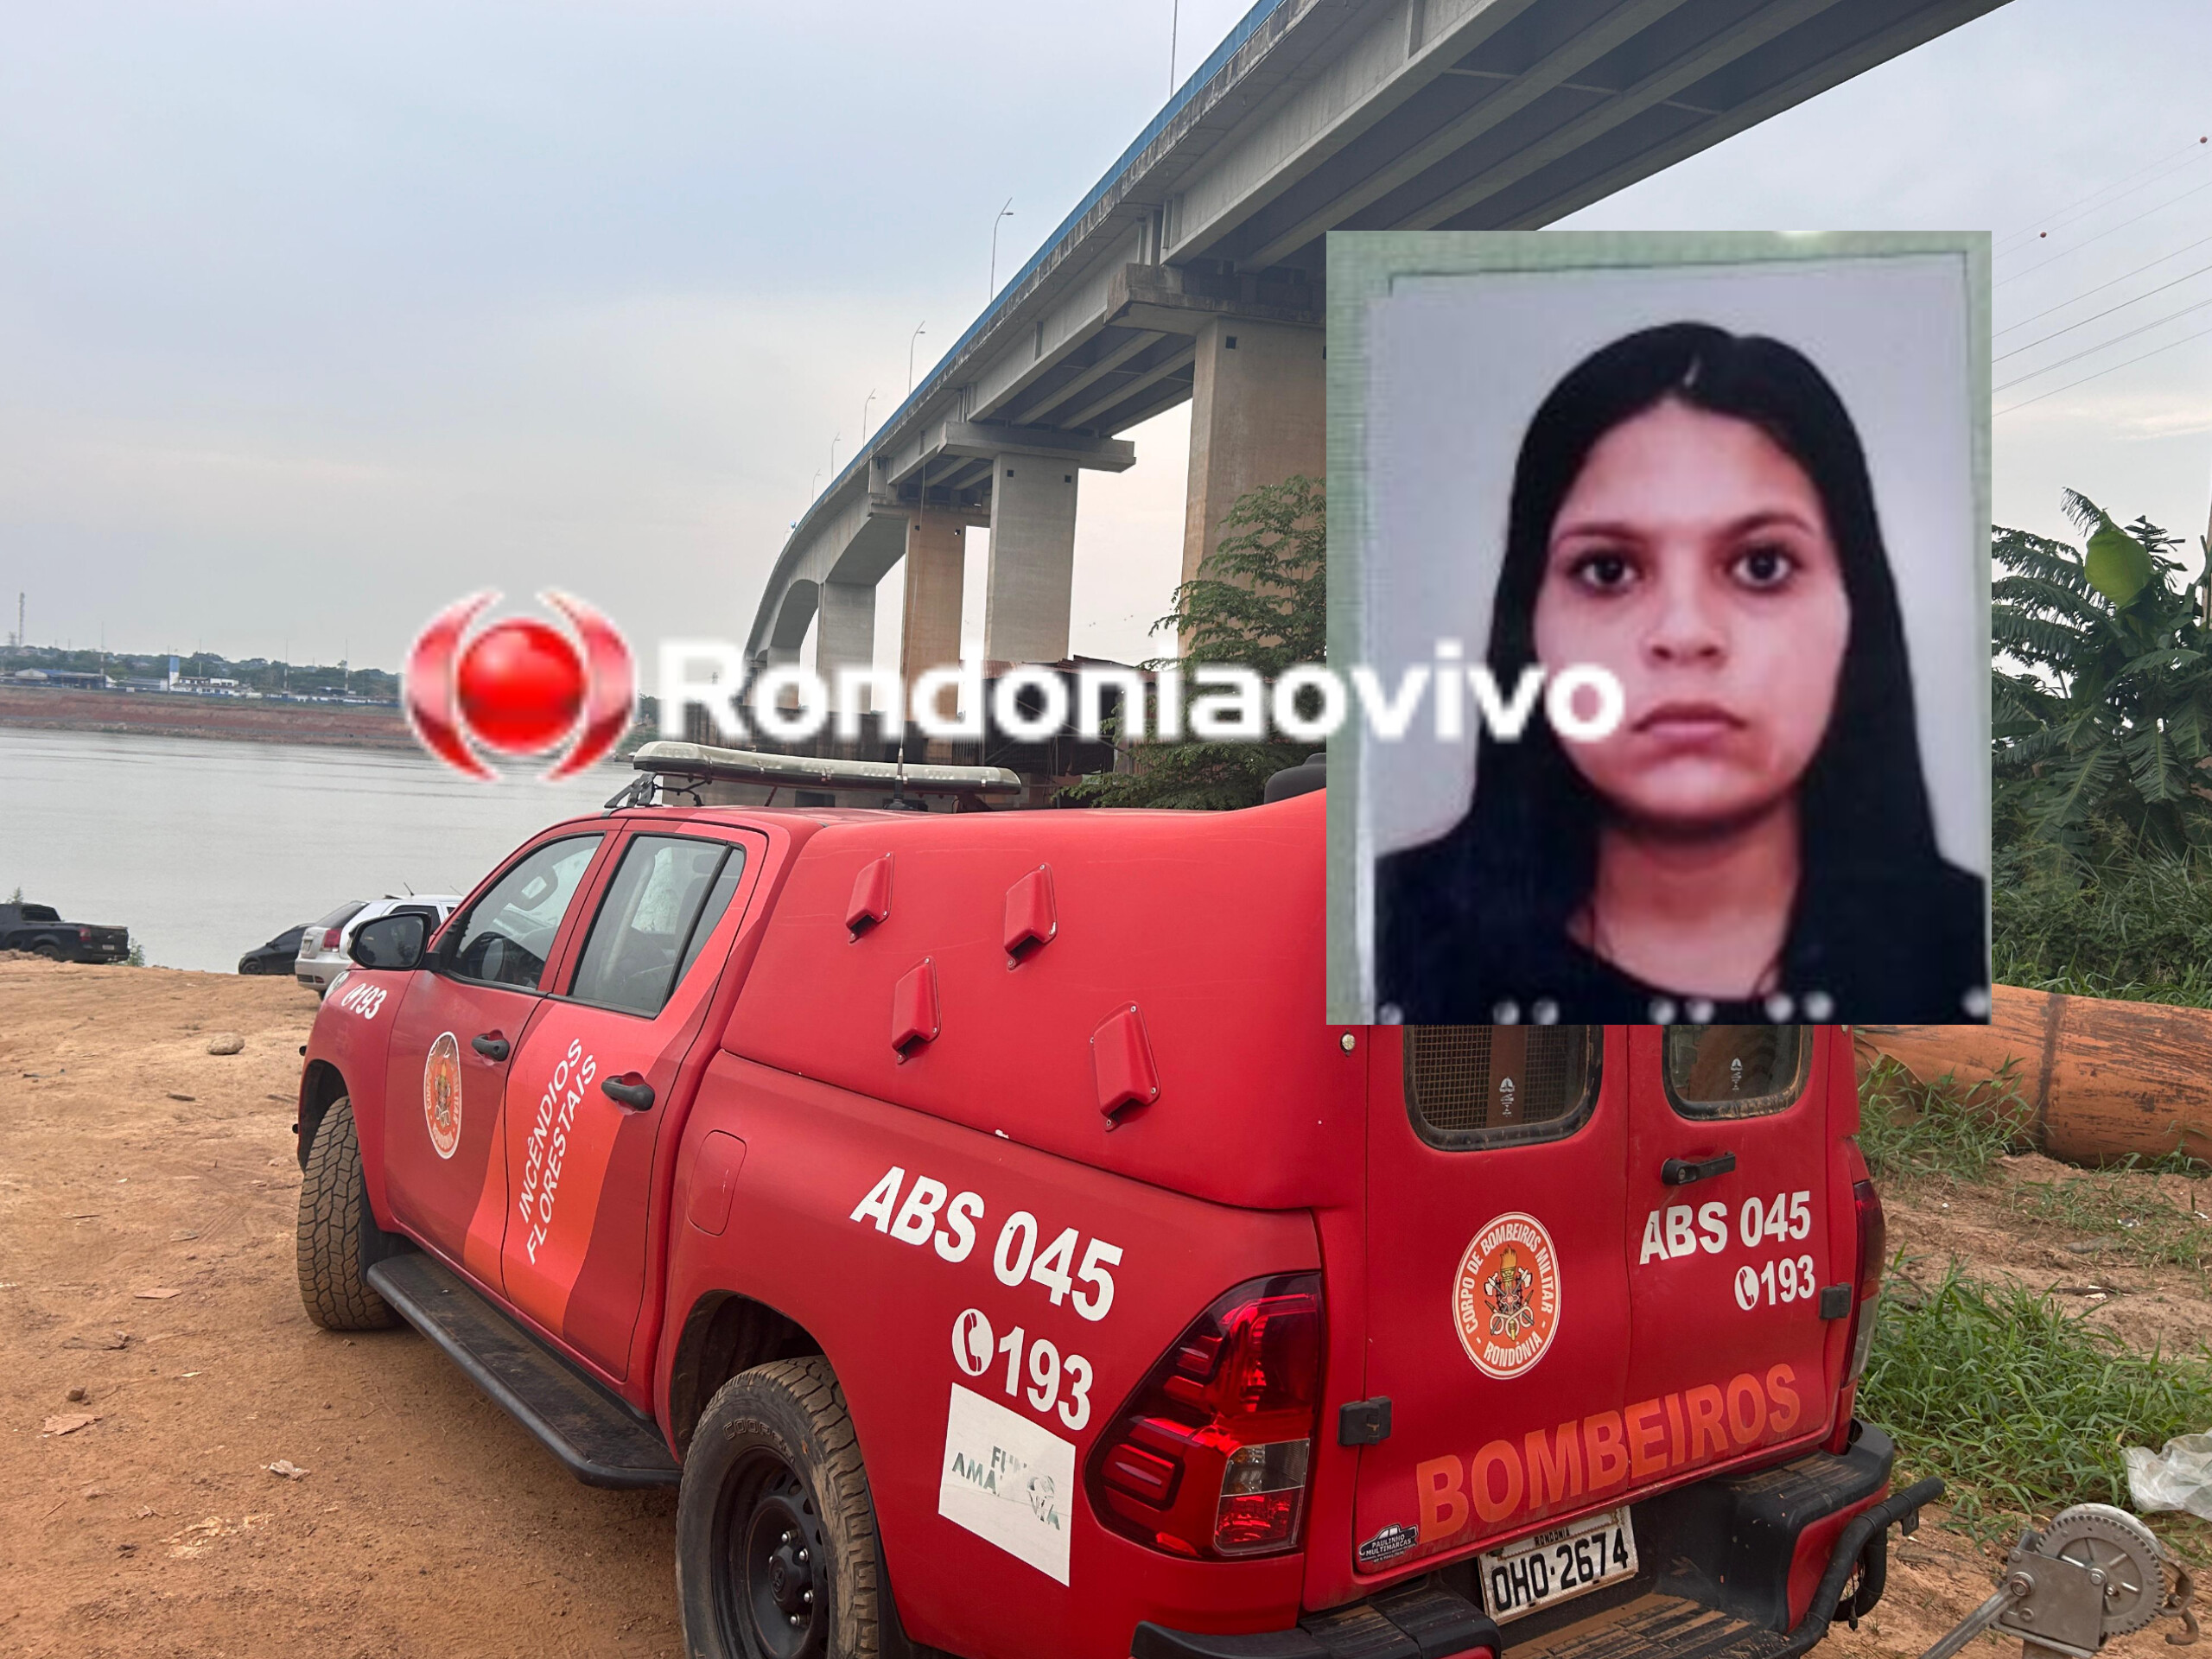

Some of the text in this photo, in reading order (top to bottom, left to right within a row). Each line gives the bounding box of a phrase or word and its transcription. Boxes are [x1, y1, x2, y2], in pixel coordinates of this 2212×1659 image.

[350, 985, 387, 1020] 193
[518, 1038, 582, 1224] INCÊNDIOS
[526, 1054, 597, 1265] FLORESTAIS
[849, 1165, 1123, 1321] ABS 045
[1639, 1190, 1811, 1265] ABS 045
[1460, 1223, 1554, 1335] CORPO DE BOMBEIROS MILITAR
[1761, 1255, 1815, 1306] 193
[999, 1325, 1093, 1431] 193
[1483, 1331, 1543, 1368] RONDÔNIA
[1416, 1363, 1801, 1545] BOMBEIROS
[1365, 1538, 1412, 1556] MULTIMARCAS
[1371, 1534, 1405, 1548] PAULINHO
